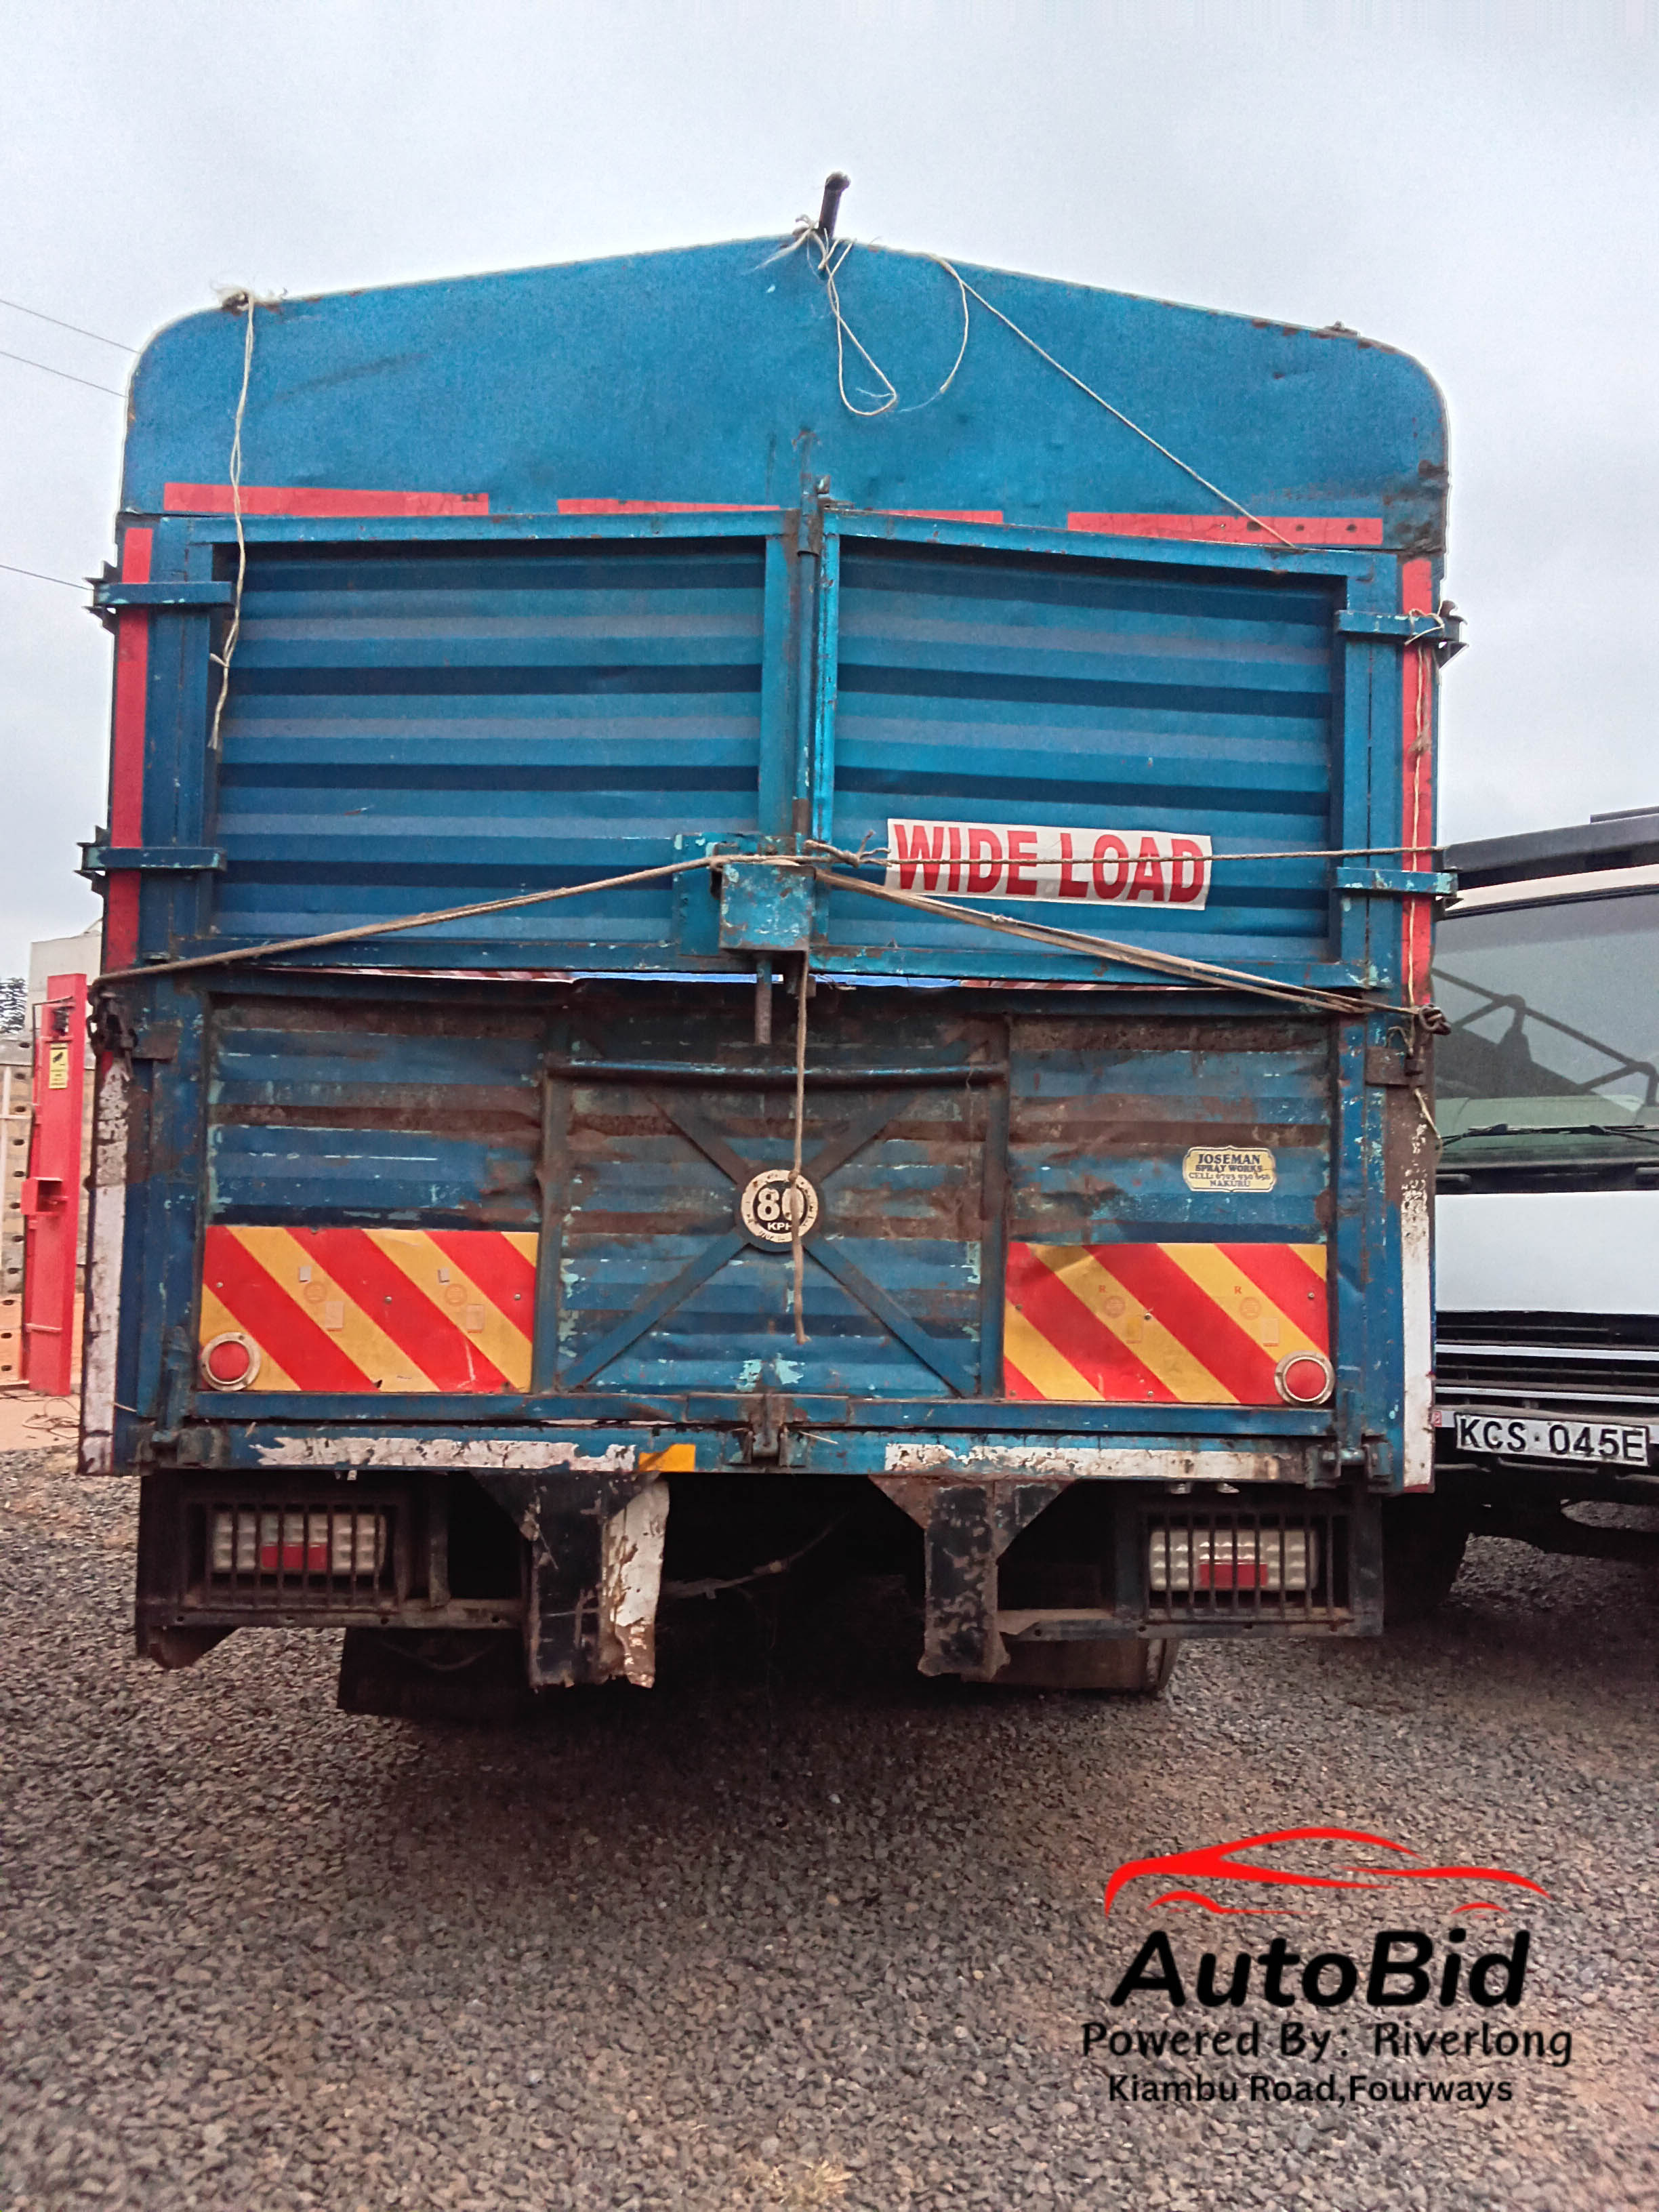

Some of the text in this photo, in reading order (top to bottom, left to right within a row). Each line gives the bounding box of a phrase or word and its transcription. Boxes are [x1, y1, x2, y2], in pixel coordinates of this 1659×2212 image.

[893, 824, 1204, 903] WIDE LOAD
[1198, 1153, 1261, 1164] JOSEMAN
[757, 1187, 804, 1221] 80
[1460, 1418, 1645, 1462] KCS 045E
